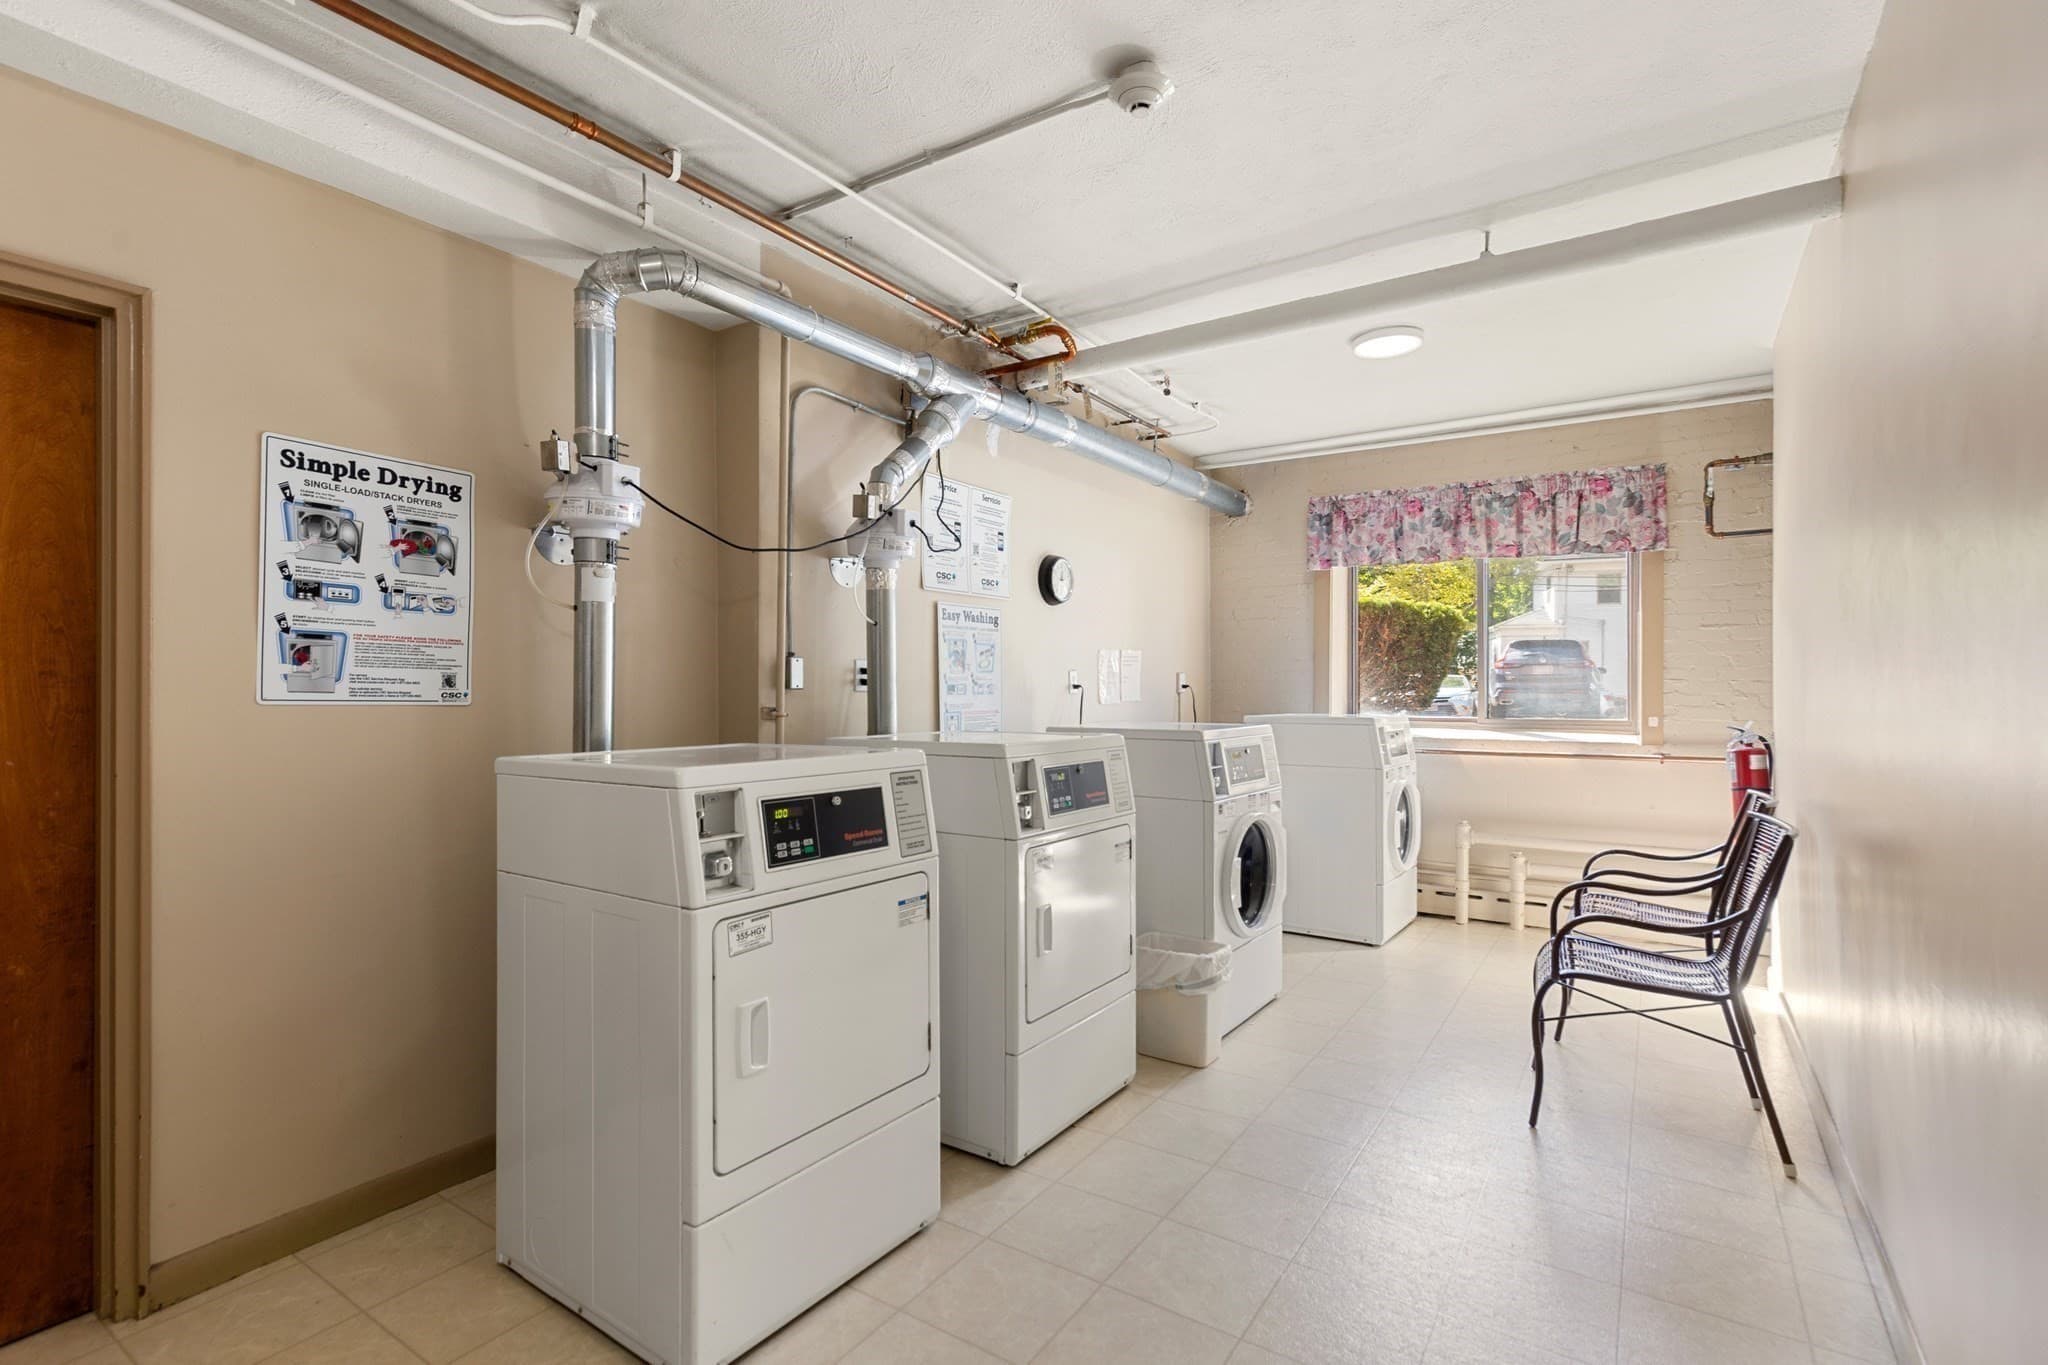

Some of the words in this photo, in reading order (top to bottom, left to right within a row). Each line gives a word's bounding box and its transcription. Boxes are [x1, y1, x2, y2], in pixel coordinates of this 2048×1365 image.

[279, 448, 370, 482] Simple
[376, 466, 463, 502] Drying
[303, 479, 404, 502] SINGLE-LOAD/STACK
[406, 495, 443, 509] DRYERS
[936, 571, 951, 580] CSC
[981, 578, 995, 587] CSC
[942, 607, 961, 624] Easy
[963, 610, 999, 628] Washing
[440, 691, 462, 699] CSC
